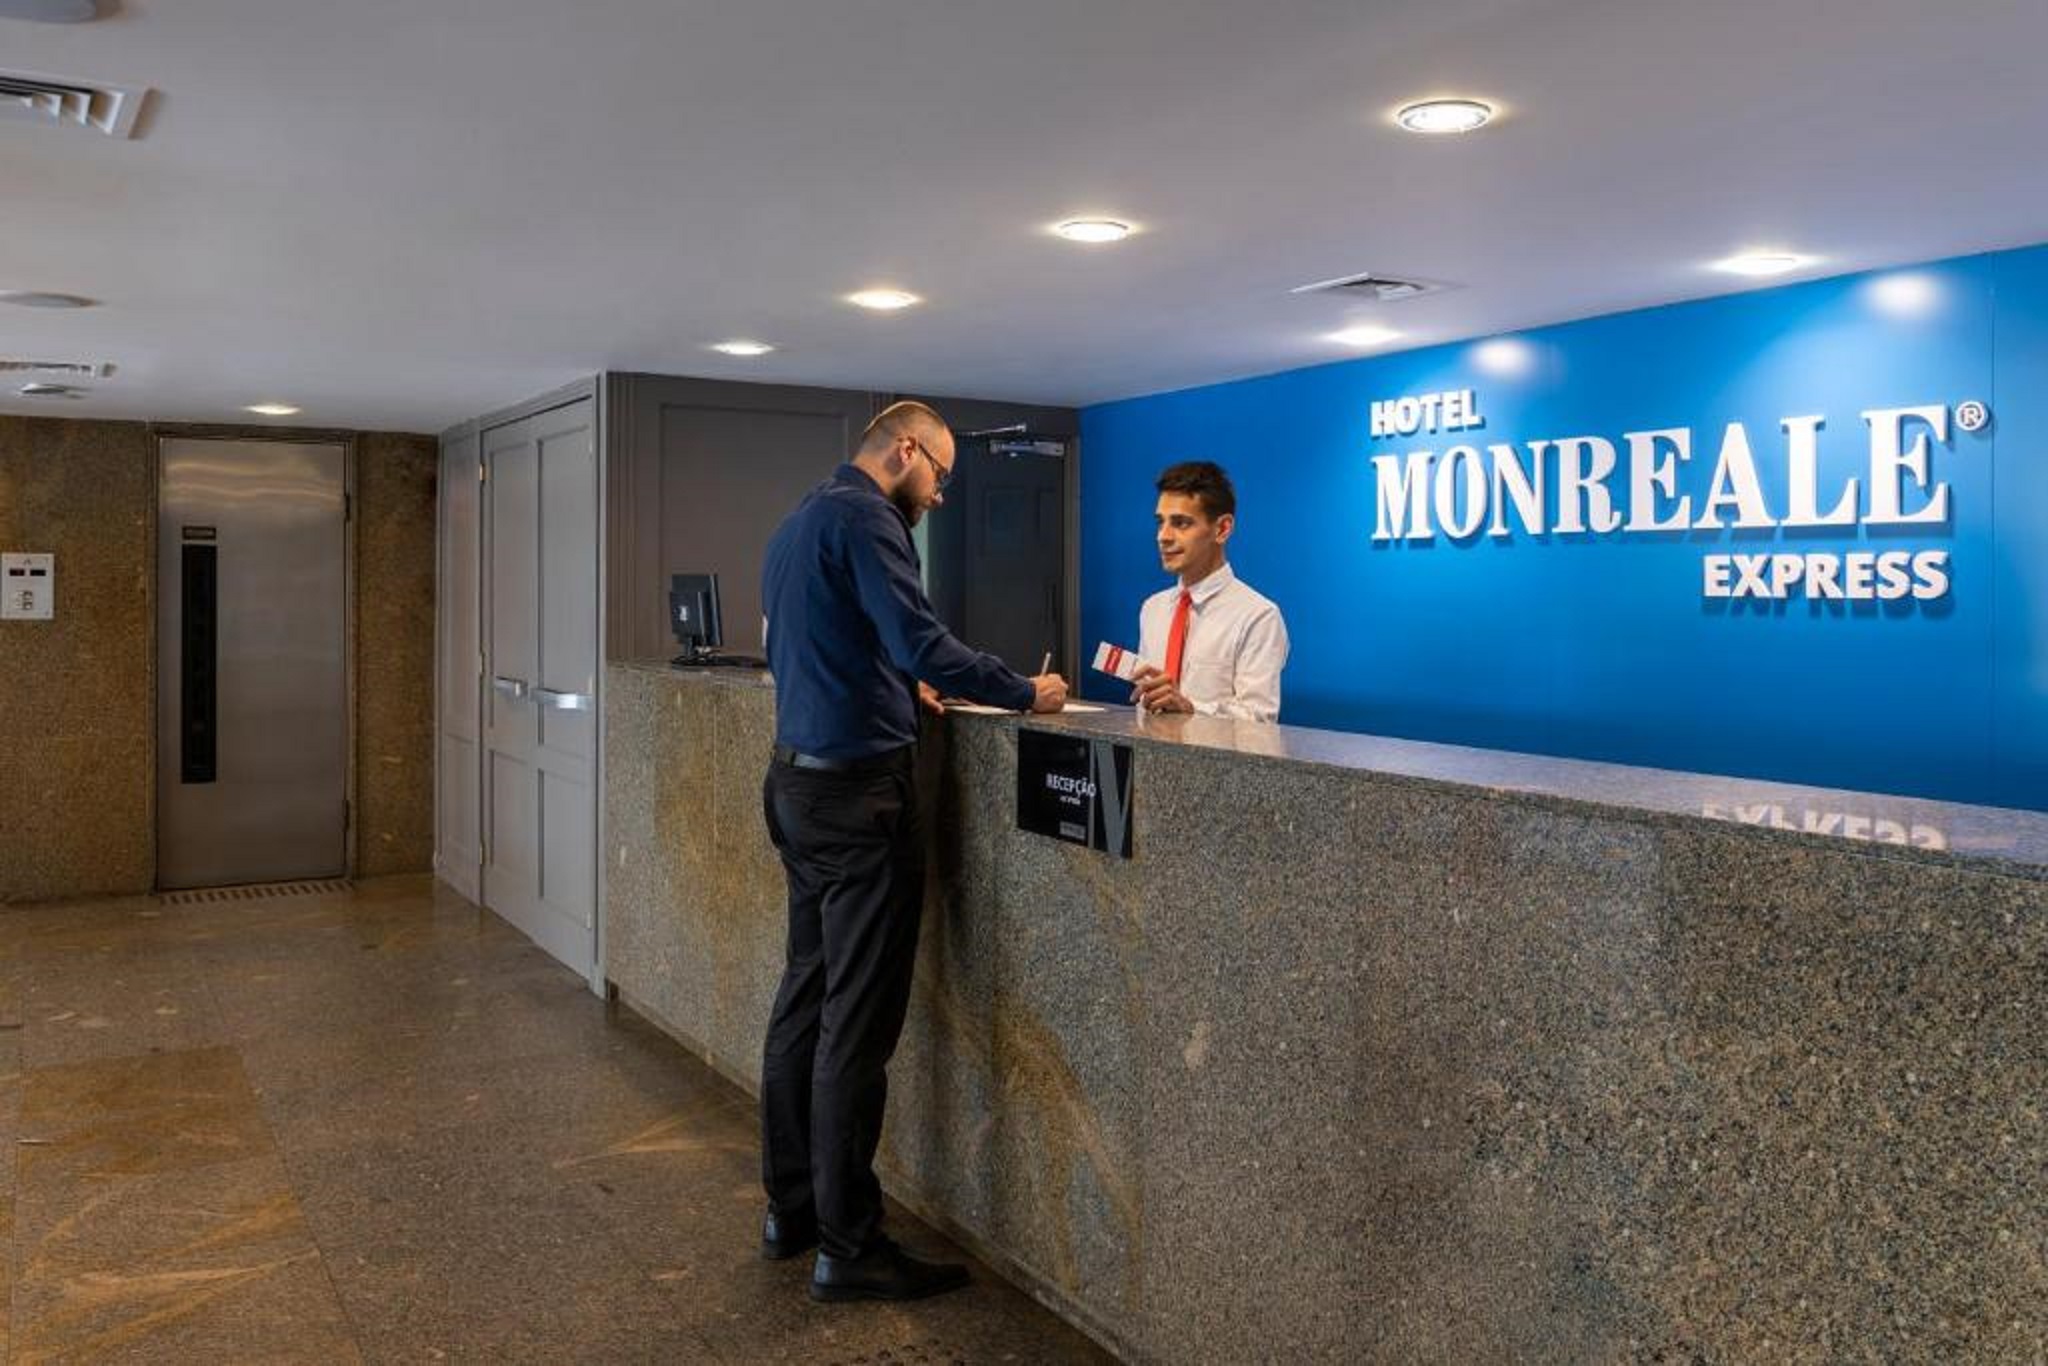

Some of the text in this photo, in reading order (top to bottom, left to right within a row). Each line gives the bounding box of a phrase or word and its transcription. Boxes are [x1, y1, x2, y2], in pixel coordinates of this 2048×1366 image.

[1371, 390, 1482, 436] HOTEL
[1371, 404, 1949, 540] MONREALE
[1704, 550, 1949, 600] EXPRESS
